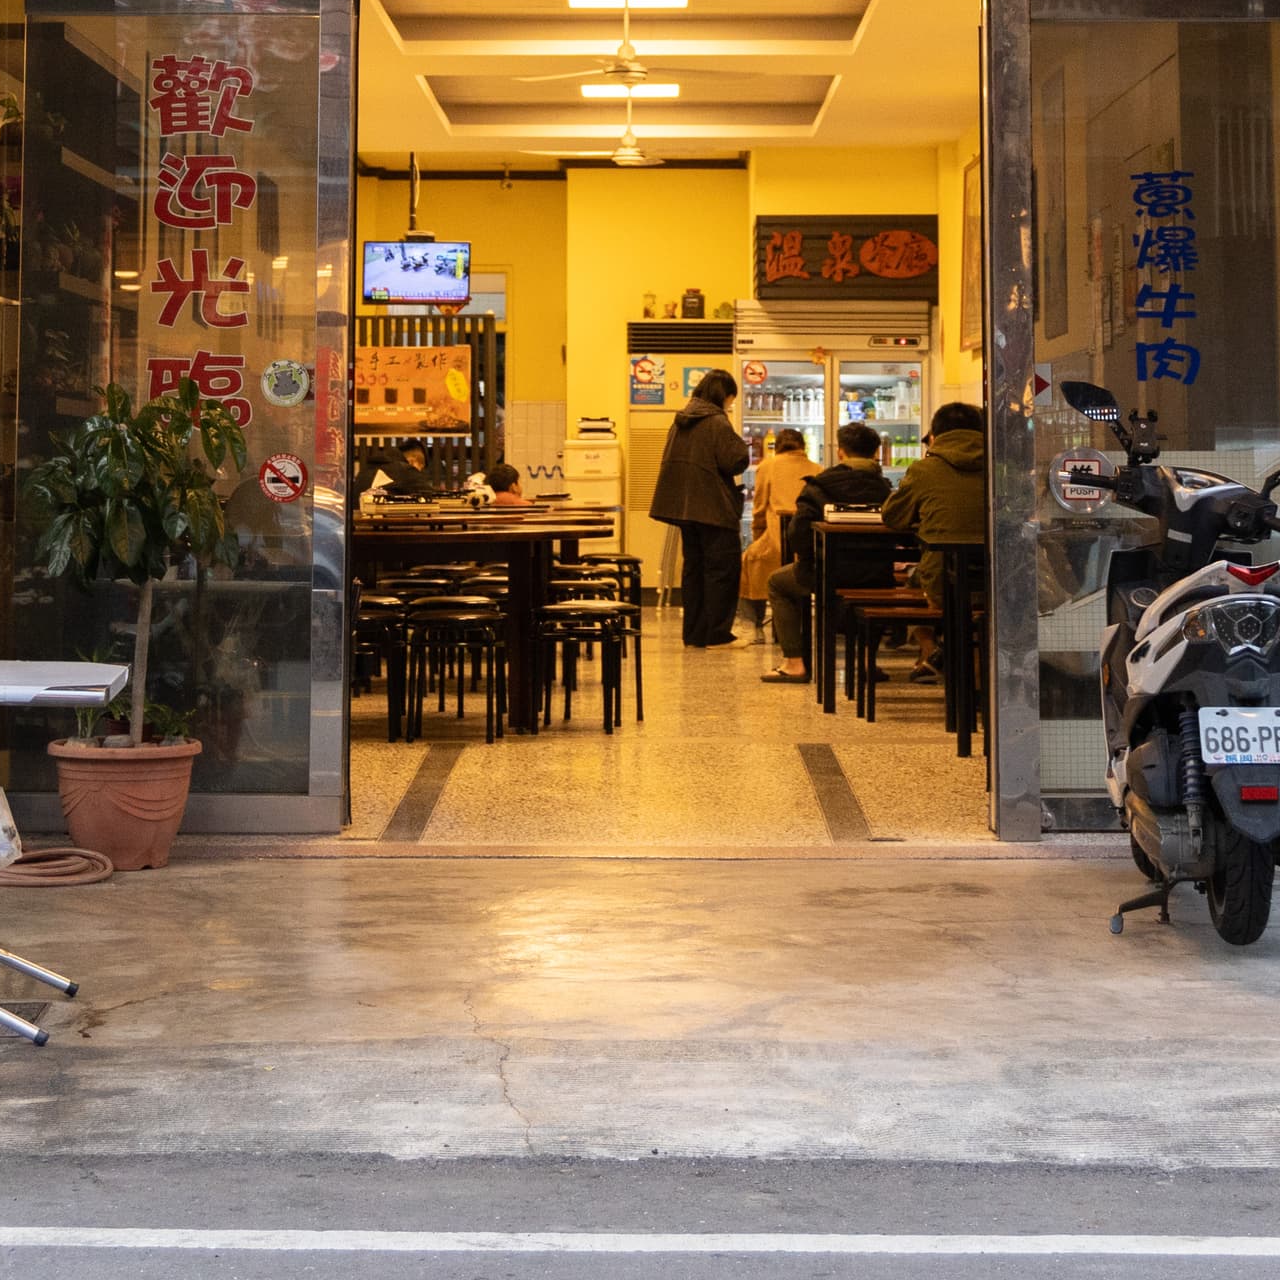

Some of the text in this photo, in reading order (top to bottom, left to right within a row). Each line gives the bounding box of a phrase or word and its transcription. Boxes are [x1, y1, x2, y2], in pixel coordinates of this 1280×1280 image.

[146, 54, 258, 431] 歡迎光臨
[1069, 487, 1095, 496] PUSH
